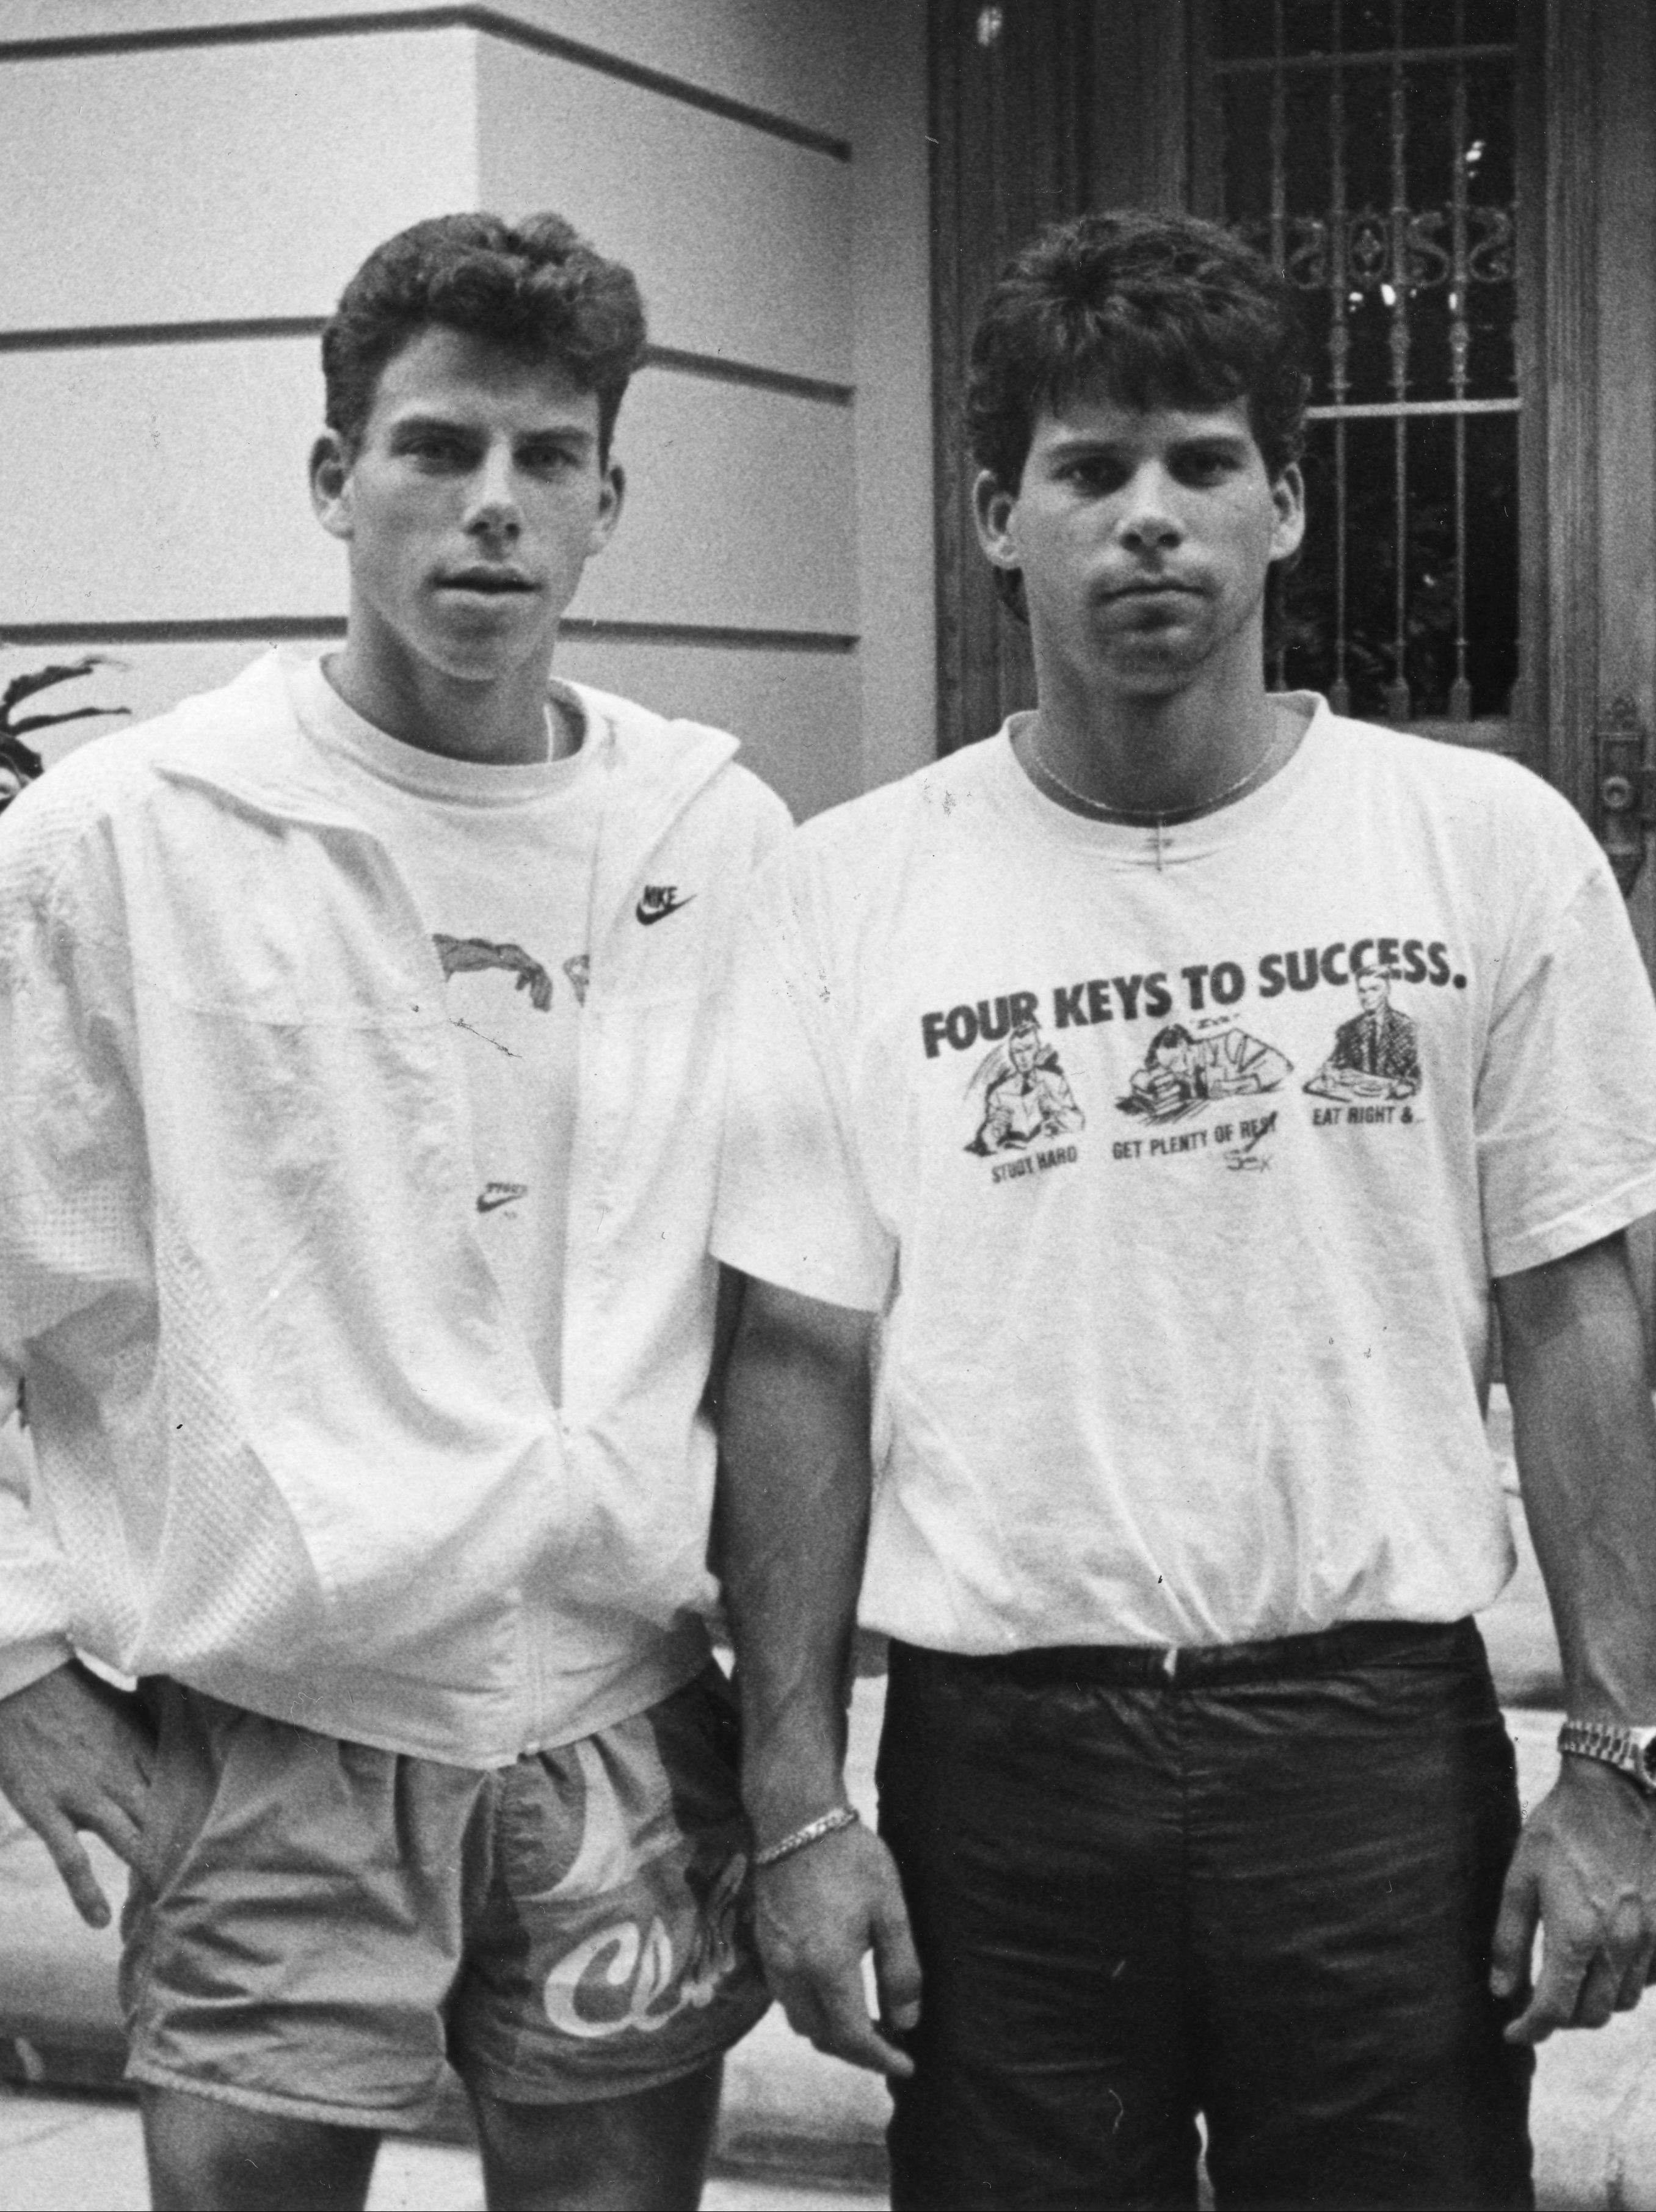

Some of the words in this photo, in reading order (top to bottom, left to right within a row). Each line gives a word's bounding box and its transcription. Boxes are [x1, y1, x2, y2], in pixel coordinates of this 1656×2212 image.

[643, 885, 677, 908] NIKE
[921, 991, 1043, 1059] FOUR
[1053, 972, 1173, 1029] KEYS
[1182, 961, 1246, 1010] TO
[1258, 937, 1468, 998] SUCCESS.
[1312, 1107, 1342, 1126] EAT
[1347, 1105, 1396, 1124] RIGHT
[1112, 1140, 1142, 1160] GET
[1150, 1129, 1208, 1156] PLENTY
[1214, 1124, 1233, 1144] OF
[1036, 1144, 1077, 1170] HARD
